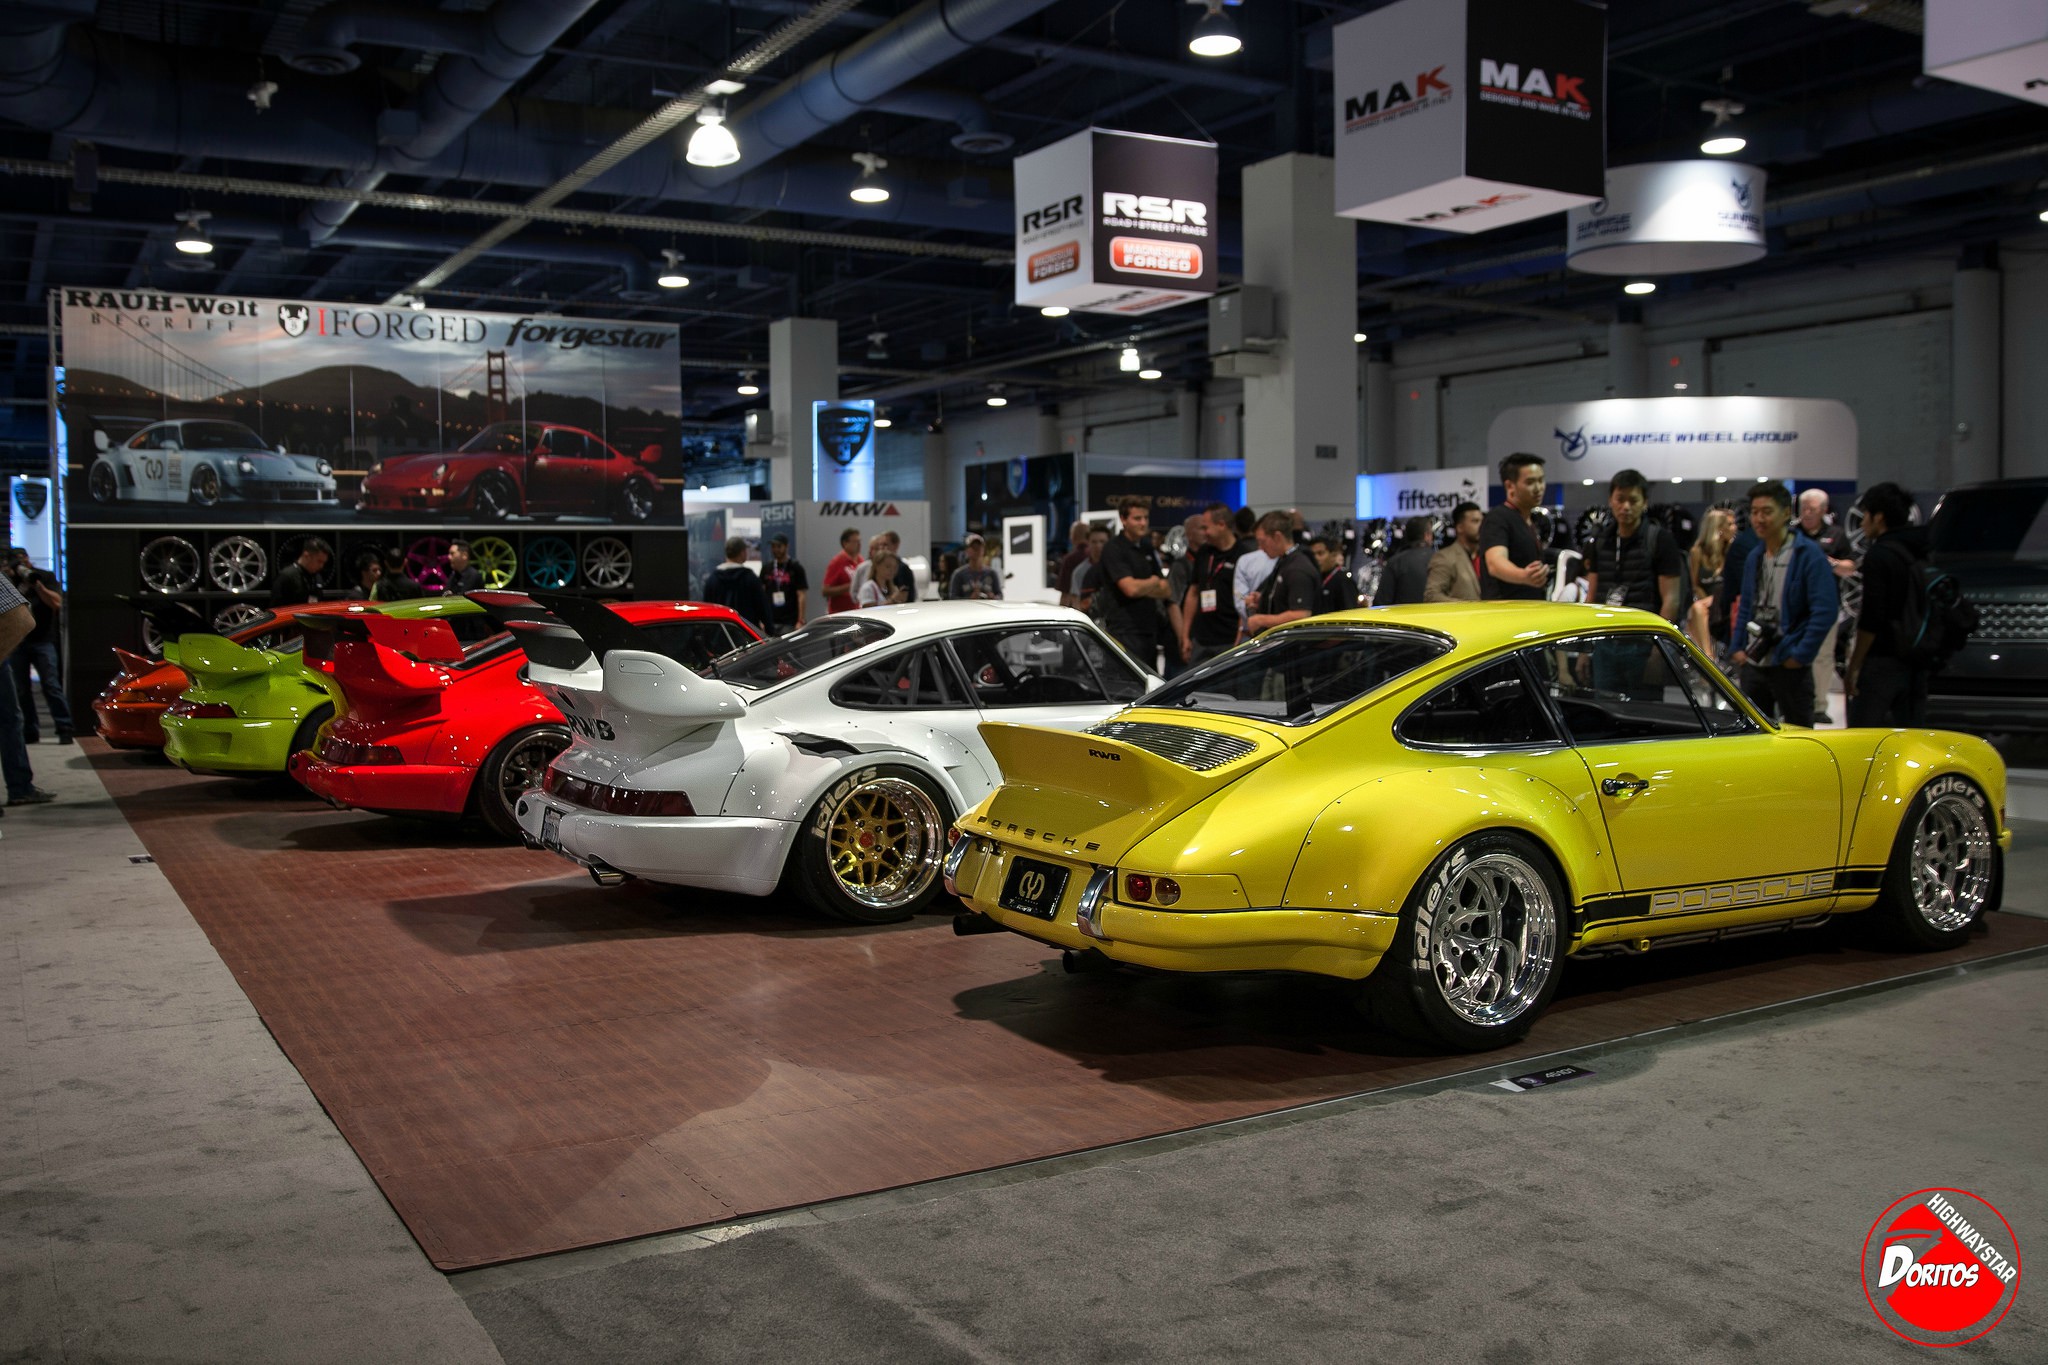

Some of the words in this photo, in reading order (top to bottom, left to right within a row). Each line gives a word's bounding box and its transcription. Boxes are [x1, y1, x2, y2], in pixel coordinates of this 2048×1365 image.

[1345, 64, 1451, 121] MAK
[1480, 58, 1589, 104] MAK
[1023, 194, 1083, 235] RSR
[1102, 191, 1208, 227] RSR
[1033, 257, 1075, 280] FORGED
[1123, 254, 1192, 272] FORGED
[65, 289, 258, 317] RAUH-Welt
[91, 313, 236, 332] BEGRIFF
[505, 317, 677, 350] forgestar
[1591, 431, 1672, 446] SUNRISE
[1676, 431, 1737, 444] WHEEL
[1743, 430, 1799, 444] GROUP
[760, 505, 795, 522] RSR
[819, 502, 886, 517] MKW
[1397, 489, 1460, 511] fifteen
[564, 711, 616, 742] RWB
[1088, 748, 1122, 762] RWB
[811, 766, 878, 840] idlers
[1923, 776, 1986, 809] idlers
[976, 815, 1101, 852] PORSCHE
[1412, 847, 1469, 971] idlers
[1650, 872, 1834, 917] PORSCHE
